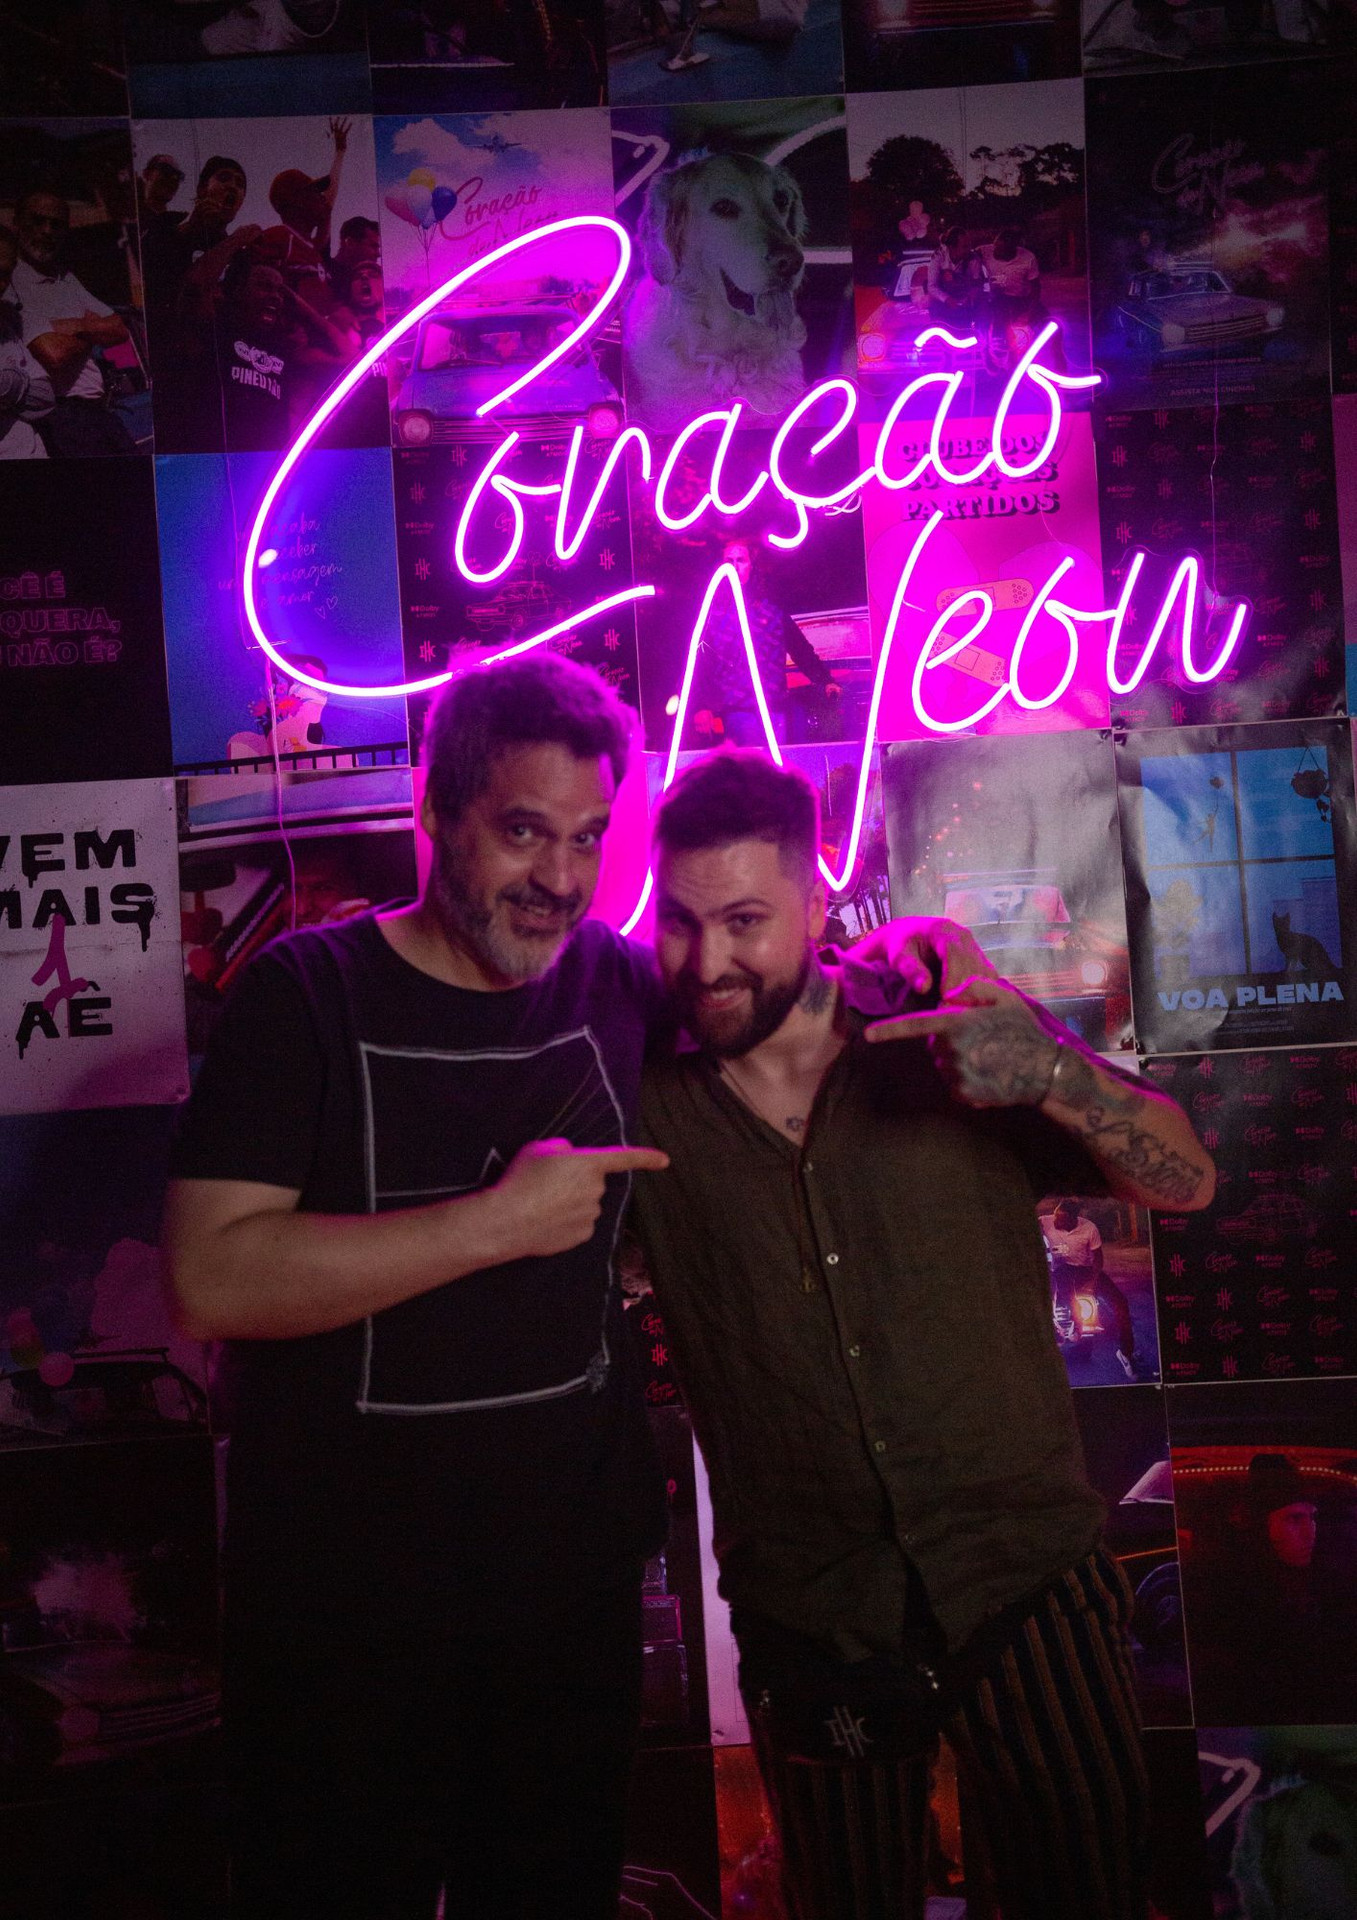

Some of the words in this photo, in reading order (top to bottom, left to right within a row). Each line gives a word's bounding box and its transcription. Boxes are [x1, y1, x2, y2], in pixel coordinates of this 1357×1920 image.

[440, 176, 542, 241] Coração
[243, 214, 1103, 699] Coração
[902, 490, 1060, 521] PARTIDOS
[45, 569, 66, 598] É
[7, 638, 56, 667] NÃO
[620, 510, 1246, 937] Neon
[16, 981, 113, 1050] AÊ
[1157, 988, 1229, 1011] VOA
[1236, 981, 1345, 1007] PLENA
